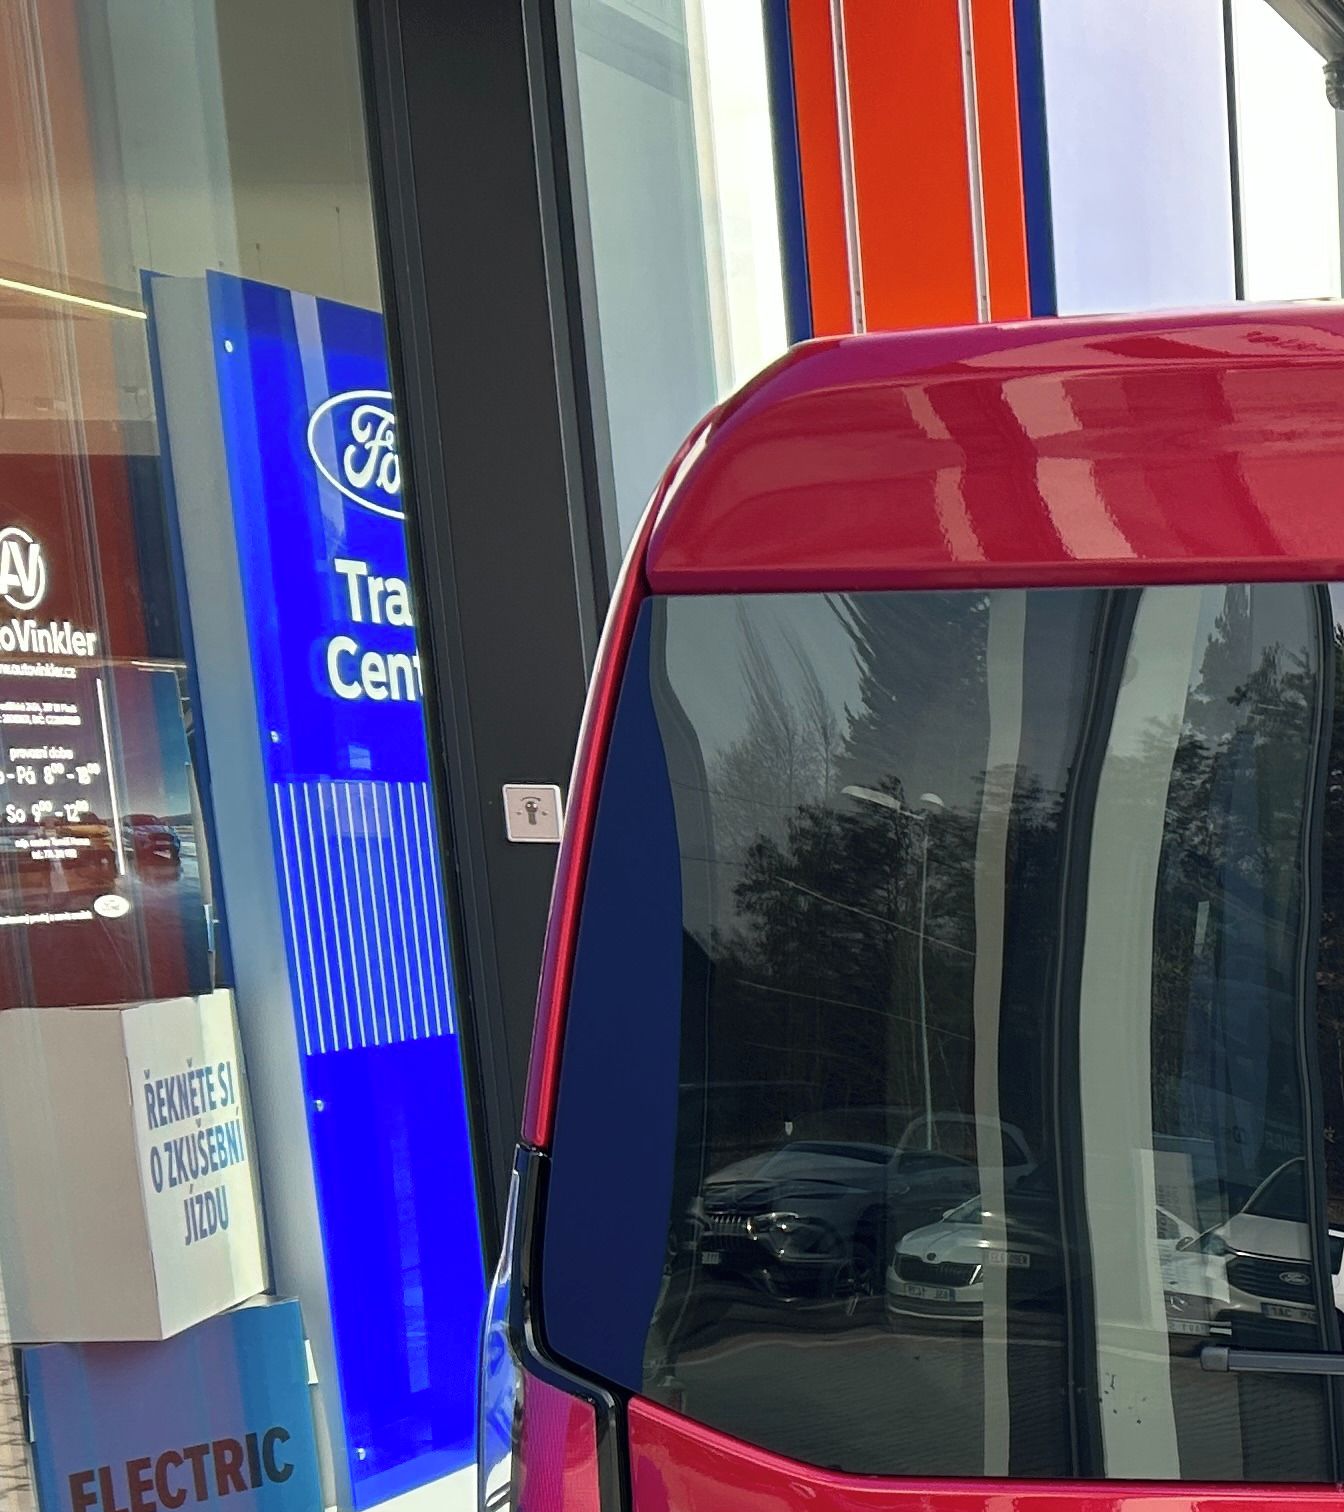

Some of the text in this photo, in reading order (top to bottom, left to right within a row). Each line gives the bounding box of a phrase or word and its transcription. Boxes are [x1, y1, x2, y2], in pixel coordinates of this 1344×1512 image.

[343, 404, 401, 495] Fo
[334, 558, 415, 627] Tra
[0, 619, 97, 657] oVinkler
[143, 1057, 235, 1130] ŘEKNĚTE SI
[150, 1107, 245, 1194] O ZKUŠEBNÍ
[184, 1184, 229, 1246] JÍZDU
